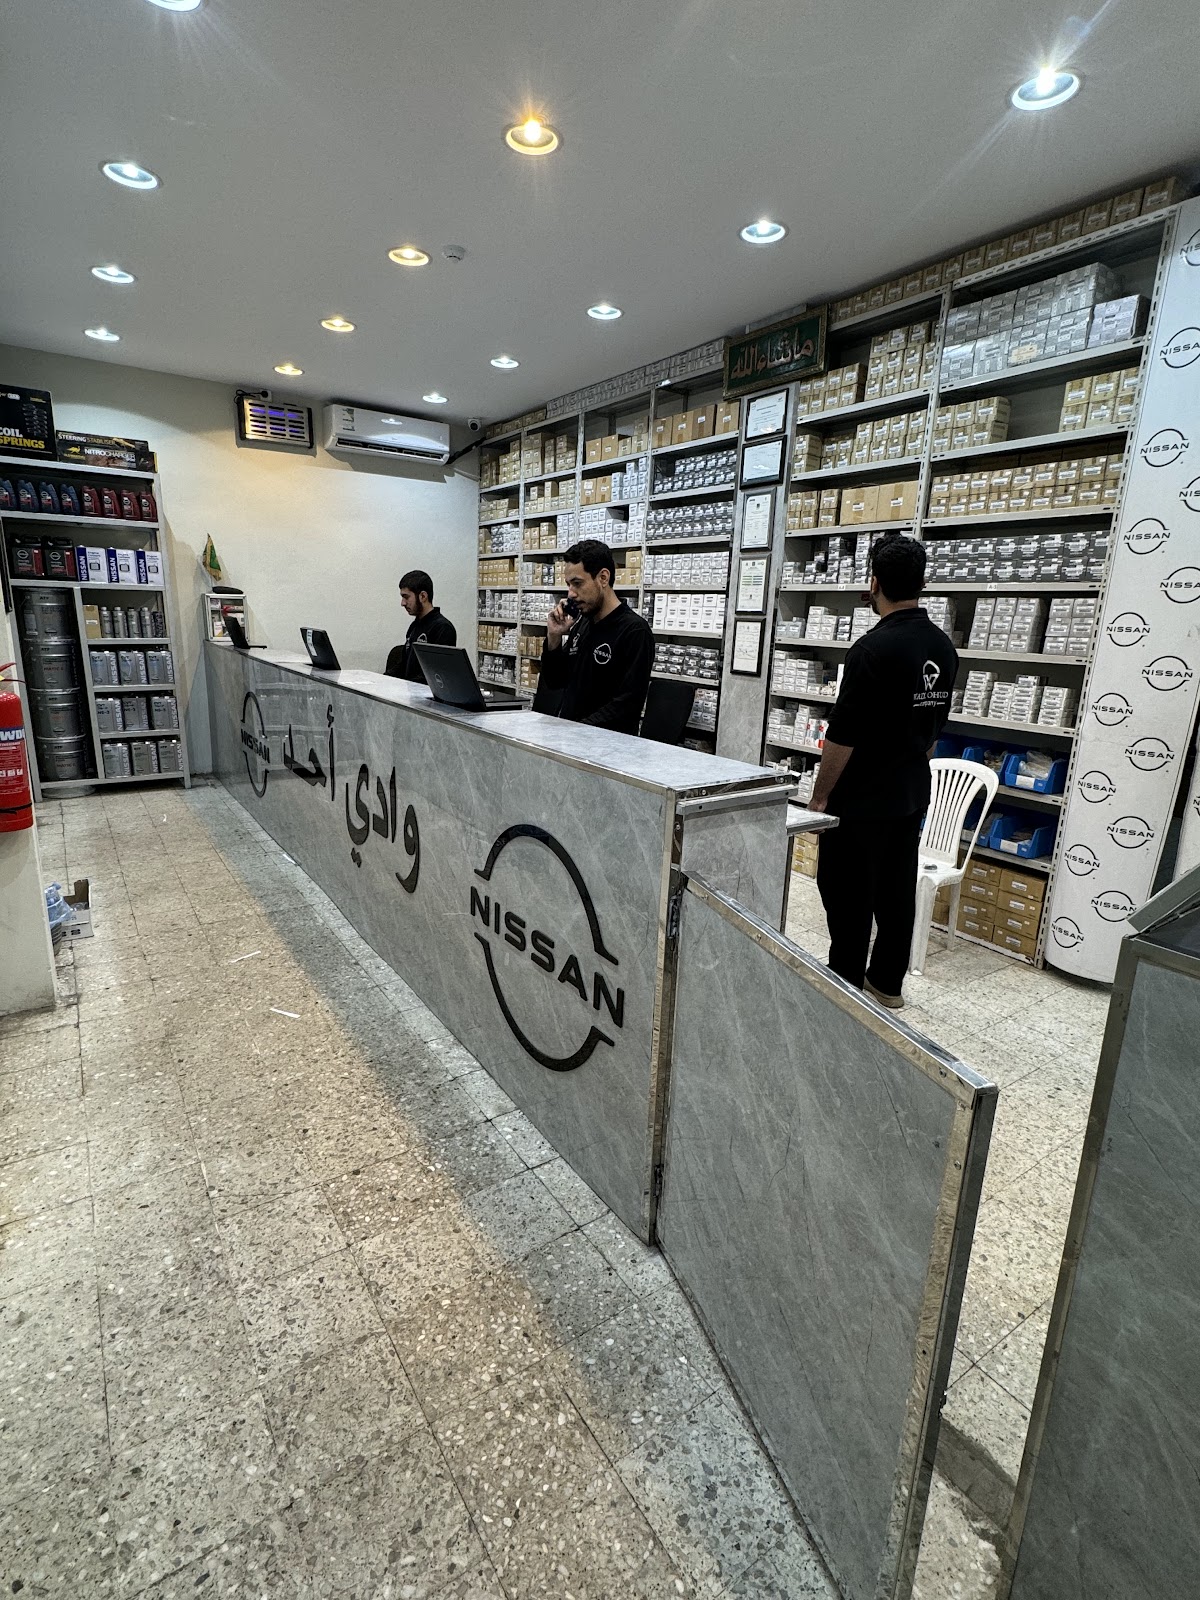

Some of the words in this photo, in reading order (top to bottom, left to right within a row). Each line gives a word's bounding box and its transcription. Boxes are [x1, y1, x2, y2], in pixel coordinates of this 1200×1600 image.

[57, 433, 87, 443] STEERING
[1139, 442, 1190, 455] NISSAN
[1123, 532, 1171, 541] NISSAN
[79, 556, 88, 581] NISSAN
[109, 557, 118, 582] NISSAN
[139, 559, 148, 583] NISSAN
[1106, 626, 1151, 634] NISSAN
[110, 654, 119, 684] NISSAN
[138, 654, 148, 684] NISSAN
[165, 653, 174, 683] NISSAN
[1141, 669, 1193, 679] NISSAN
[115, 700, 124, 731] NISSAN
[170, 699, 179, 729] NISSAN
[1091, 704, 1134, 715] NISSAN
[240, 728, 270, 764] NISSAN
[1125, 748, 1175, 760] NISSAN
[122, 747, 131, 775] NISSAN
[149, 744, 158, 773] NISSAN
[1077, 780, 1117, 793] NISSAN
[345, 763, 420, 894] وادي
[1106, 826, 1155, 839] NISSAN
[1064, 852, 1100, 868] NISSAN
[1091, 898, 1137, 912] NISSAN
[1051, 922, 1085, 942] NISSAN
[470, 886, 625, 1029] NISSAN
